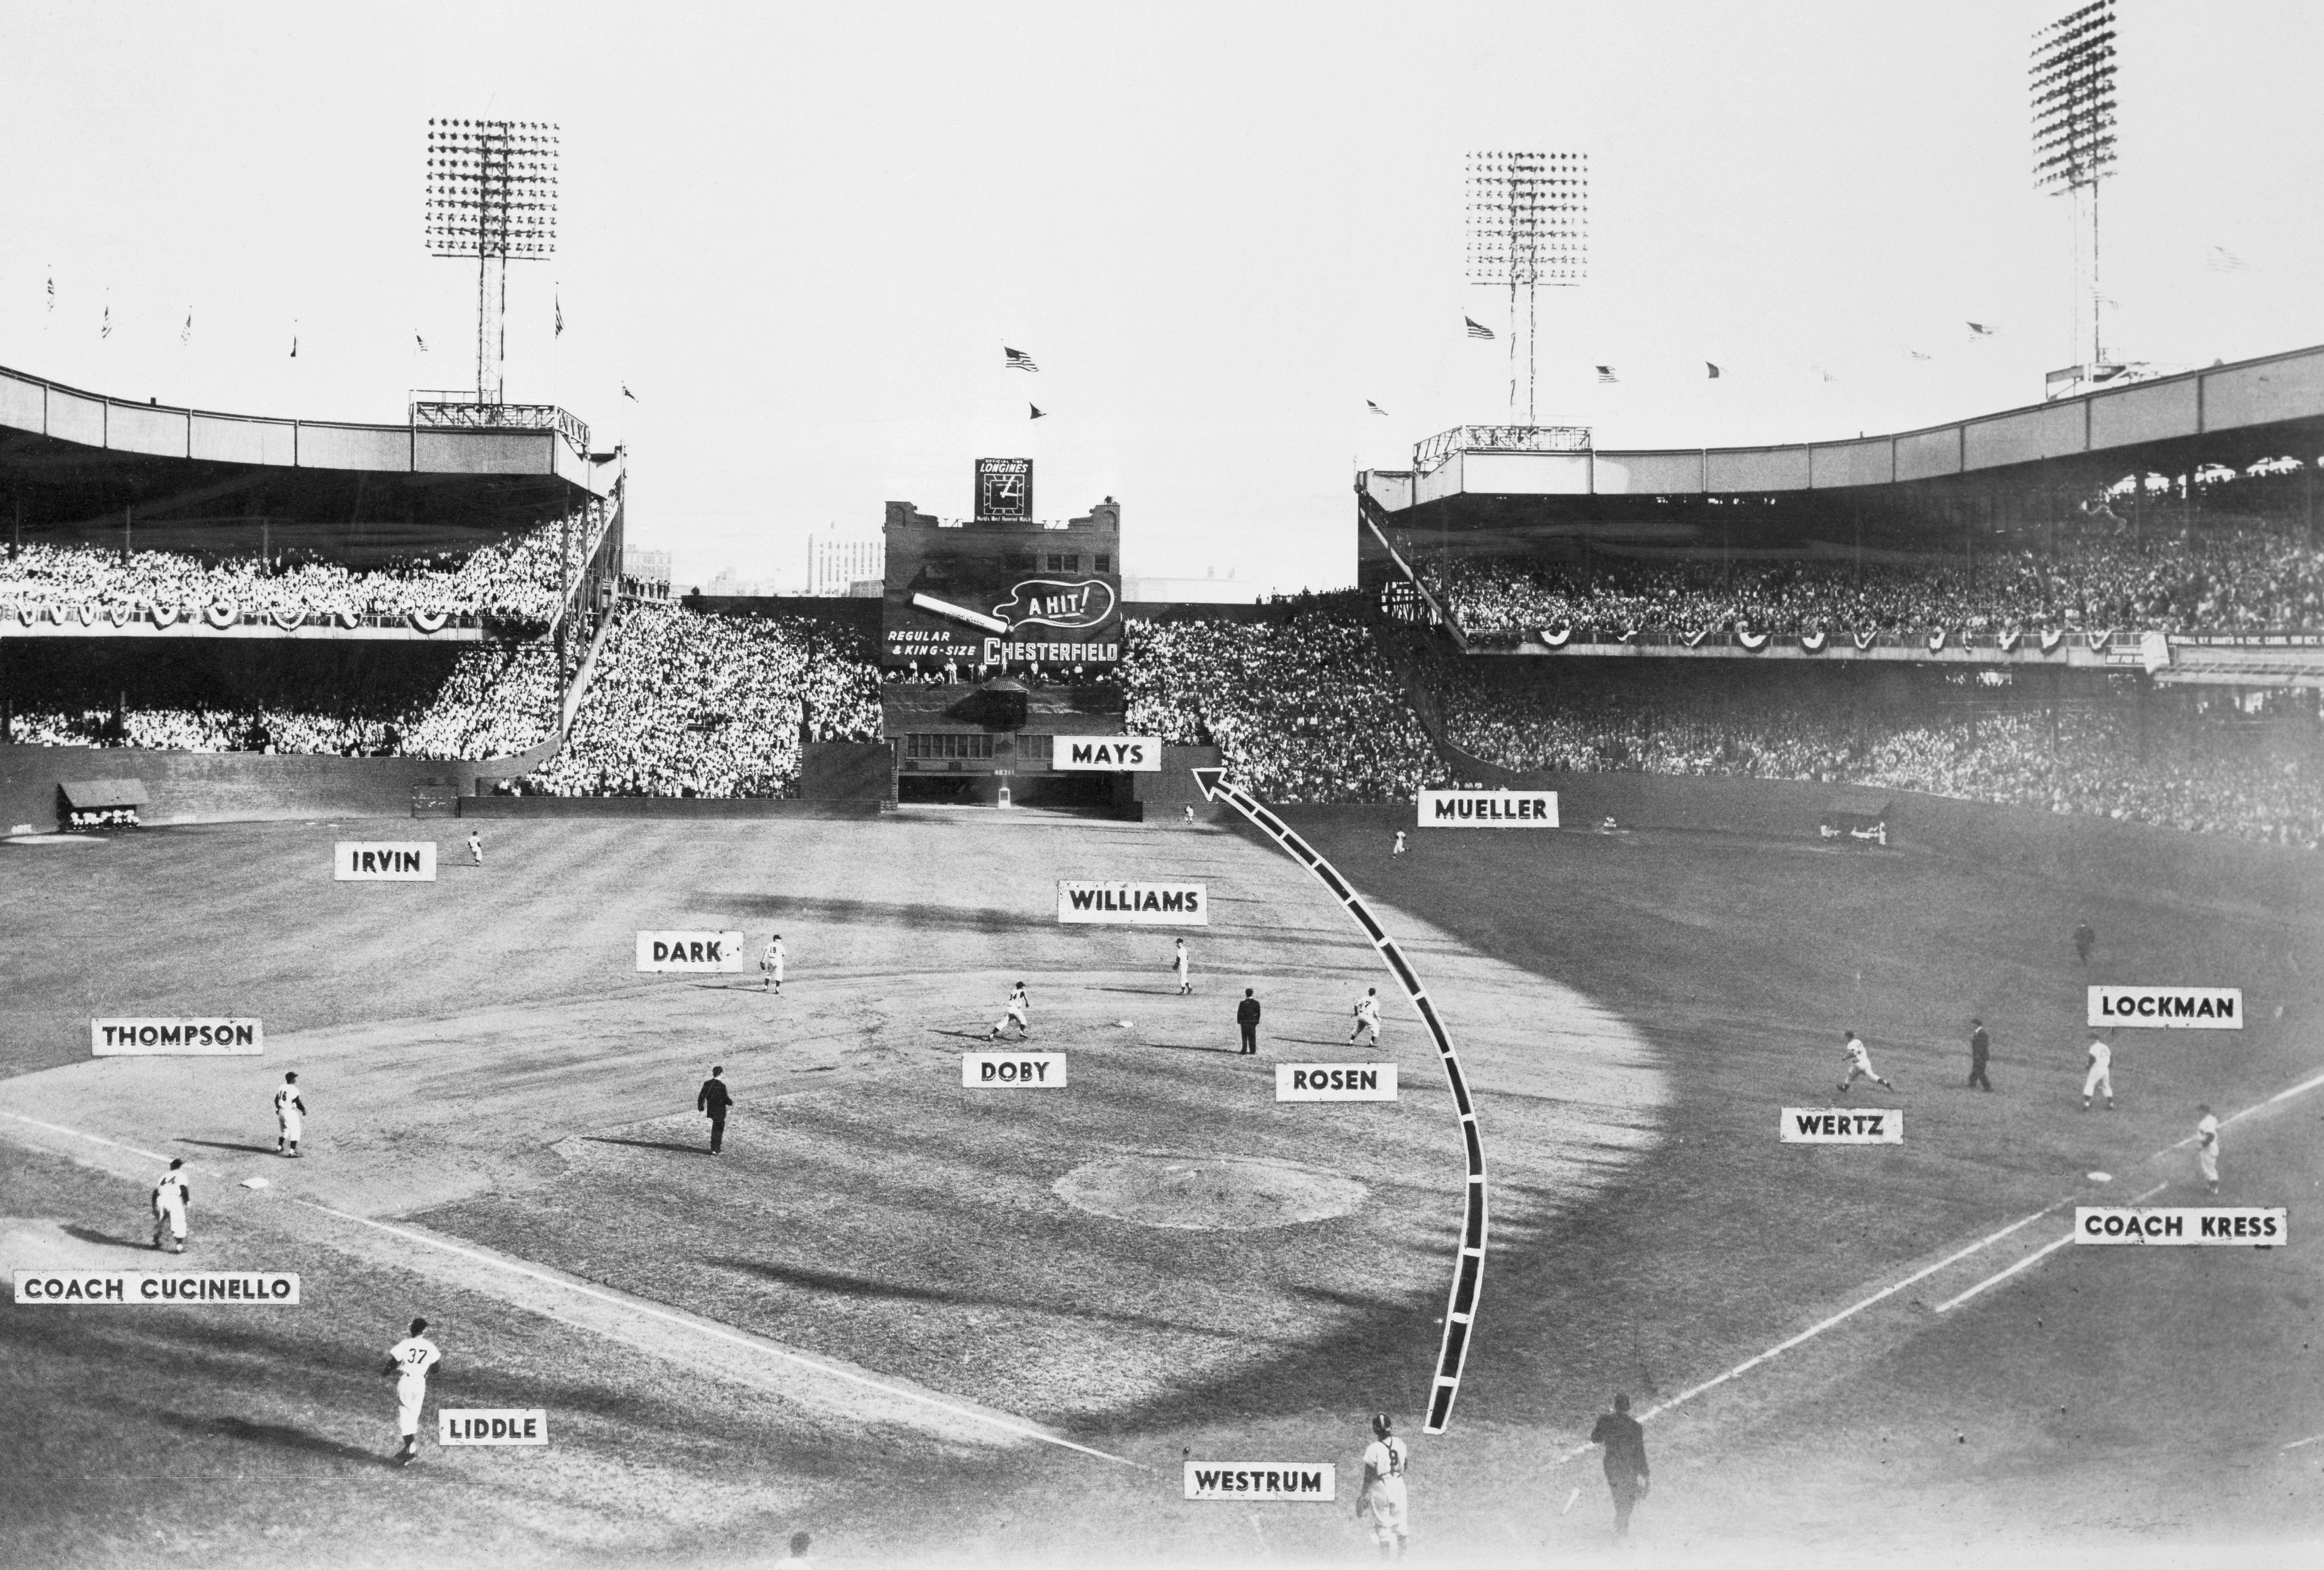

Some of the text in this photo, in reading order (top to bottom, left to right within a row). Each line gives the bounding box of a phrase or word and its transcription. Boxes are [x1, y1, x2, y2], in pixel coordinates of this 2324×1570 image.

[980, 463, 1028, 472] LONGINES
[1029, 587, 1090, 615] A HIT!
[888, 631, 950, 641] REGULAR
[893, 645, 976, 655] & KING-SIZE
[984, 637, 1118, 665] CHESTERFIELD
[408, 1348, 427, 1364] 37
